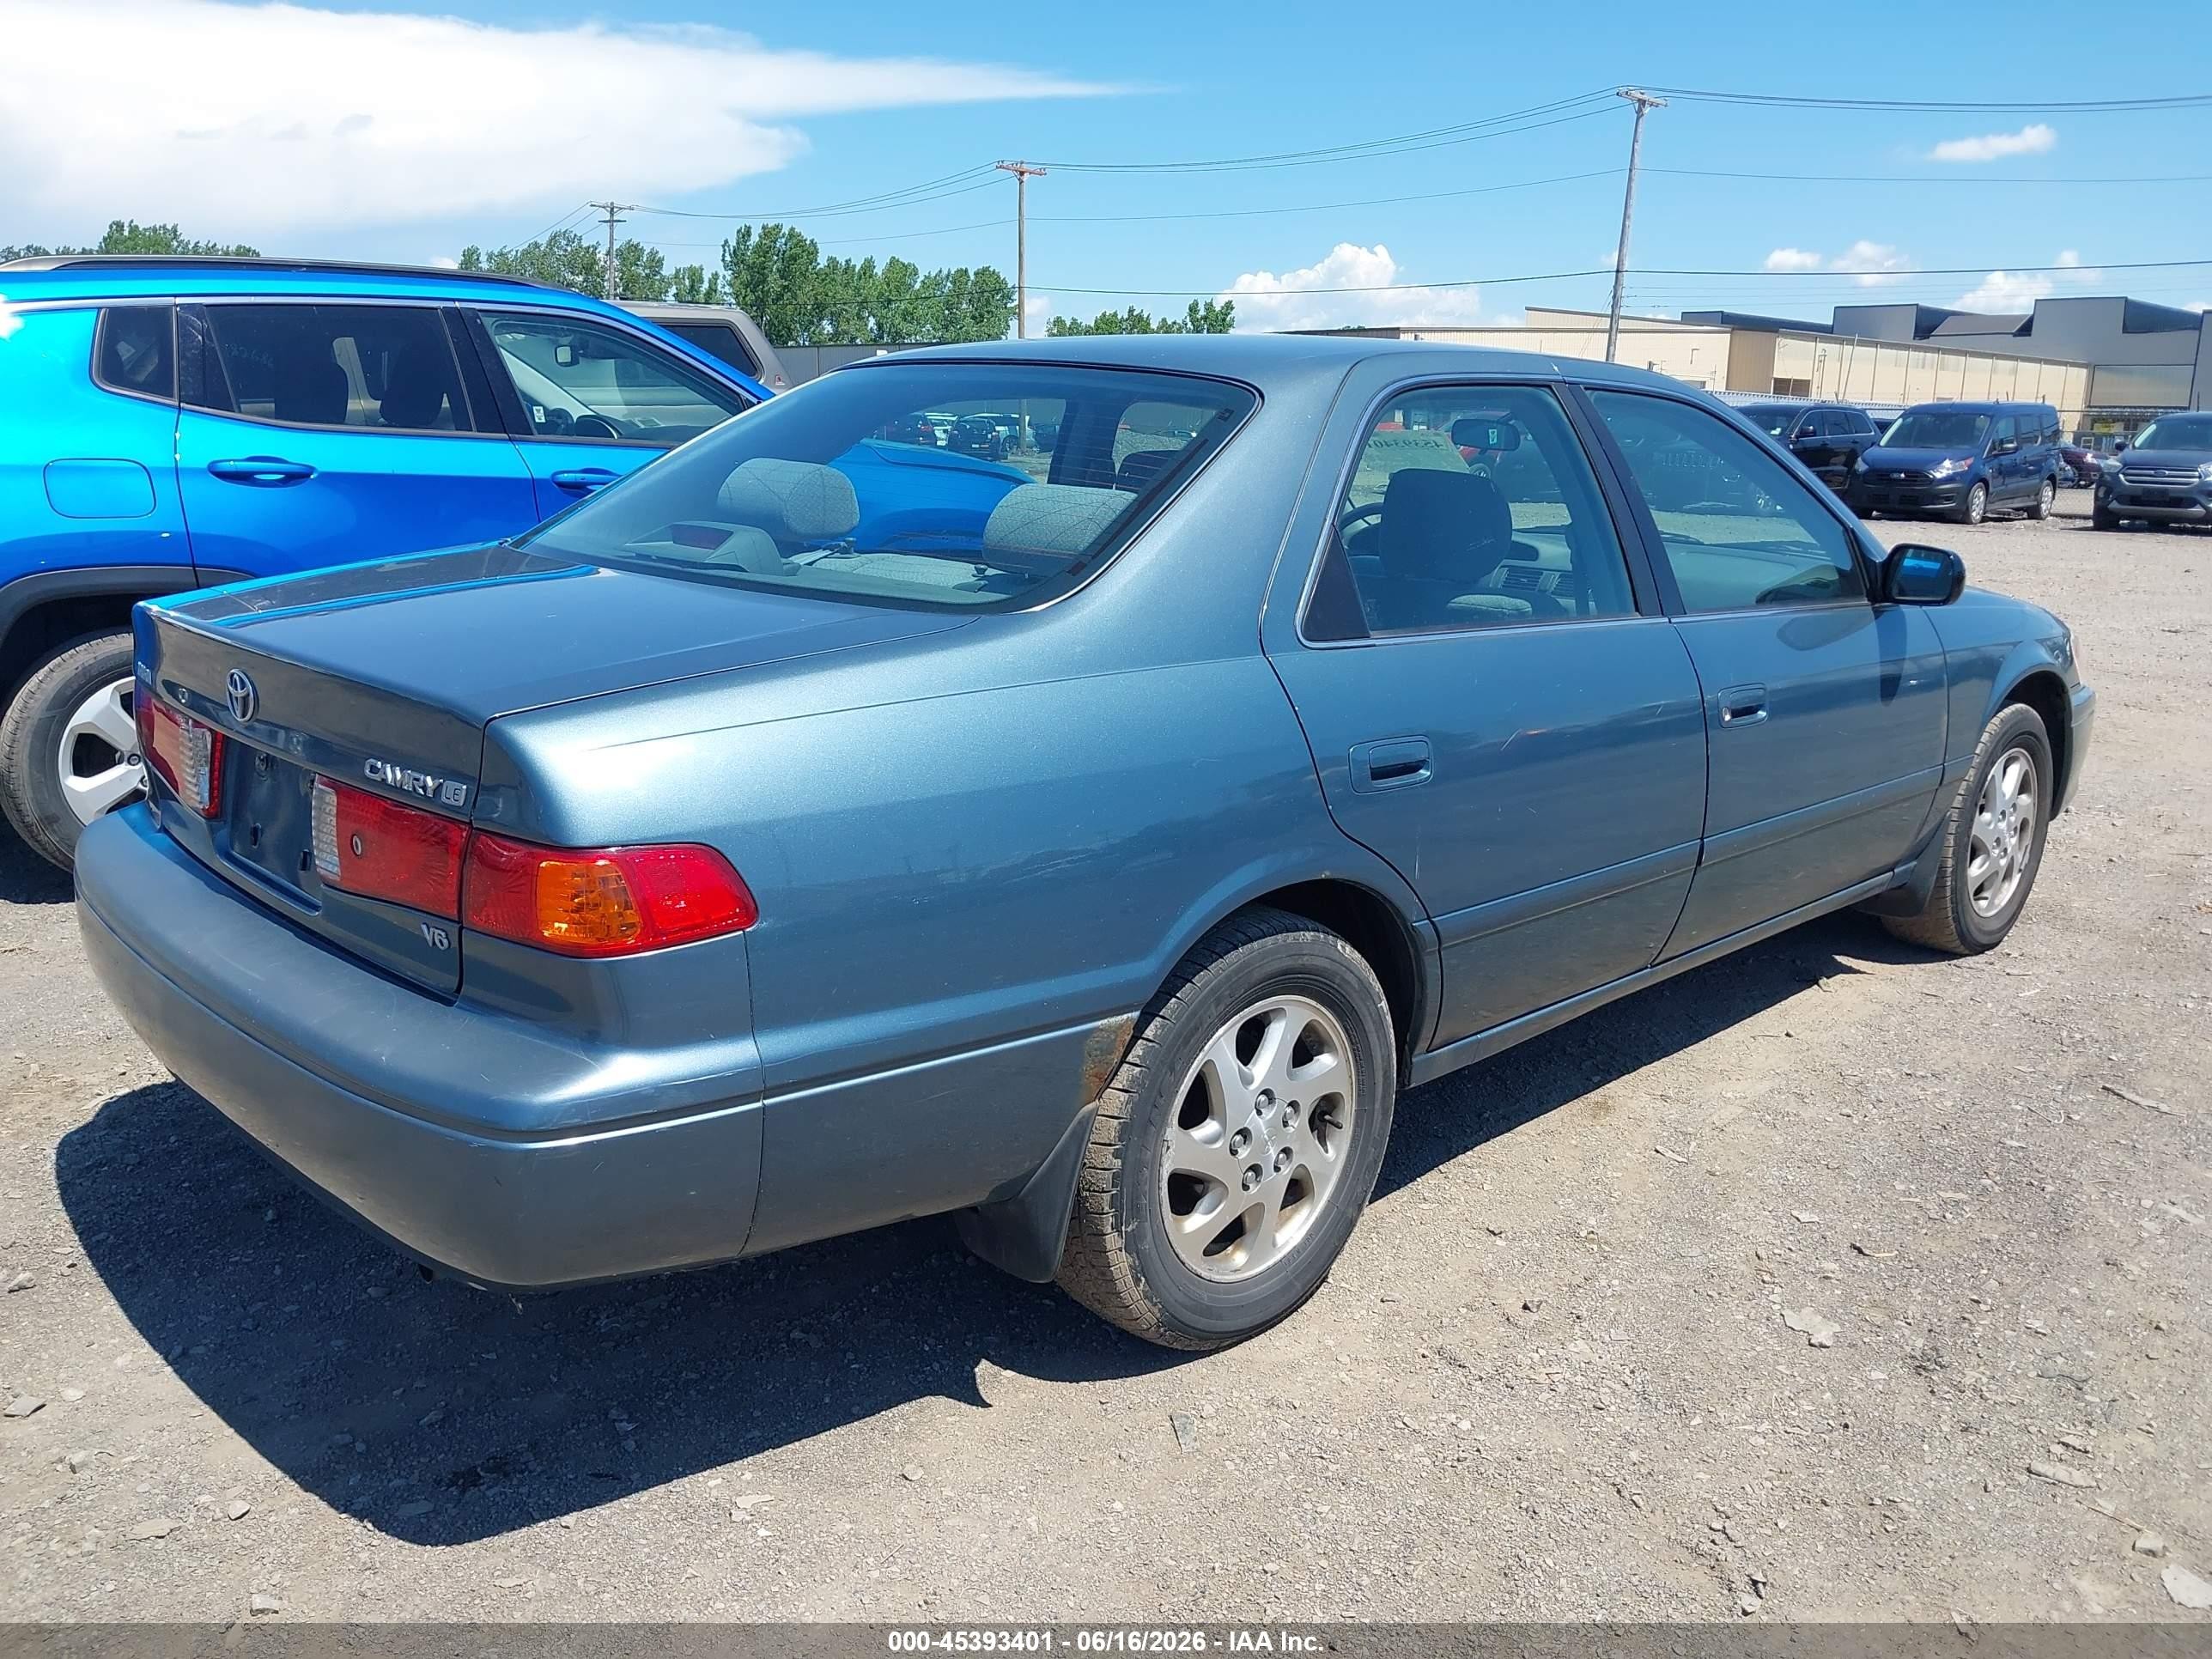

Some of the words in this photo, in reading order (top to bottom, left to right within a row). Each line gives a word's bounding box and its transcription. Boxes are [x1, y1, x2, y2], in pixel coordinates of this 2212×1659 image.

[364, 757, 444, 798] CAMRY
[443, 782, 465, 805] LE
[421, 923, 449, 951] V6
